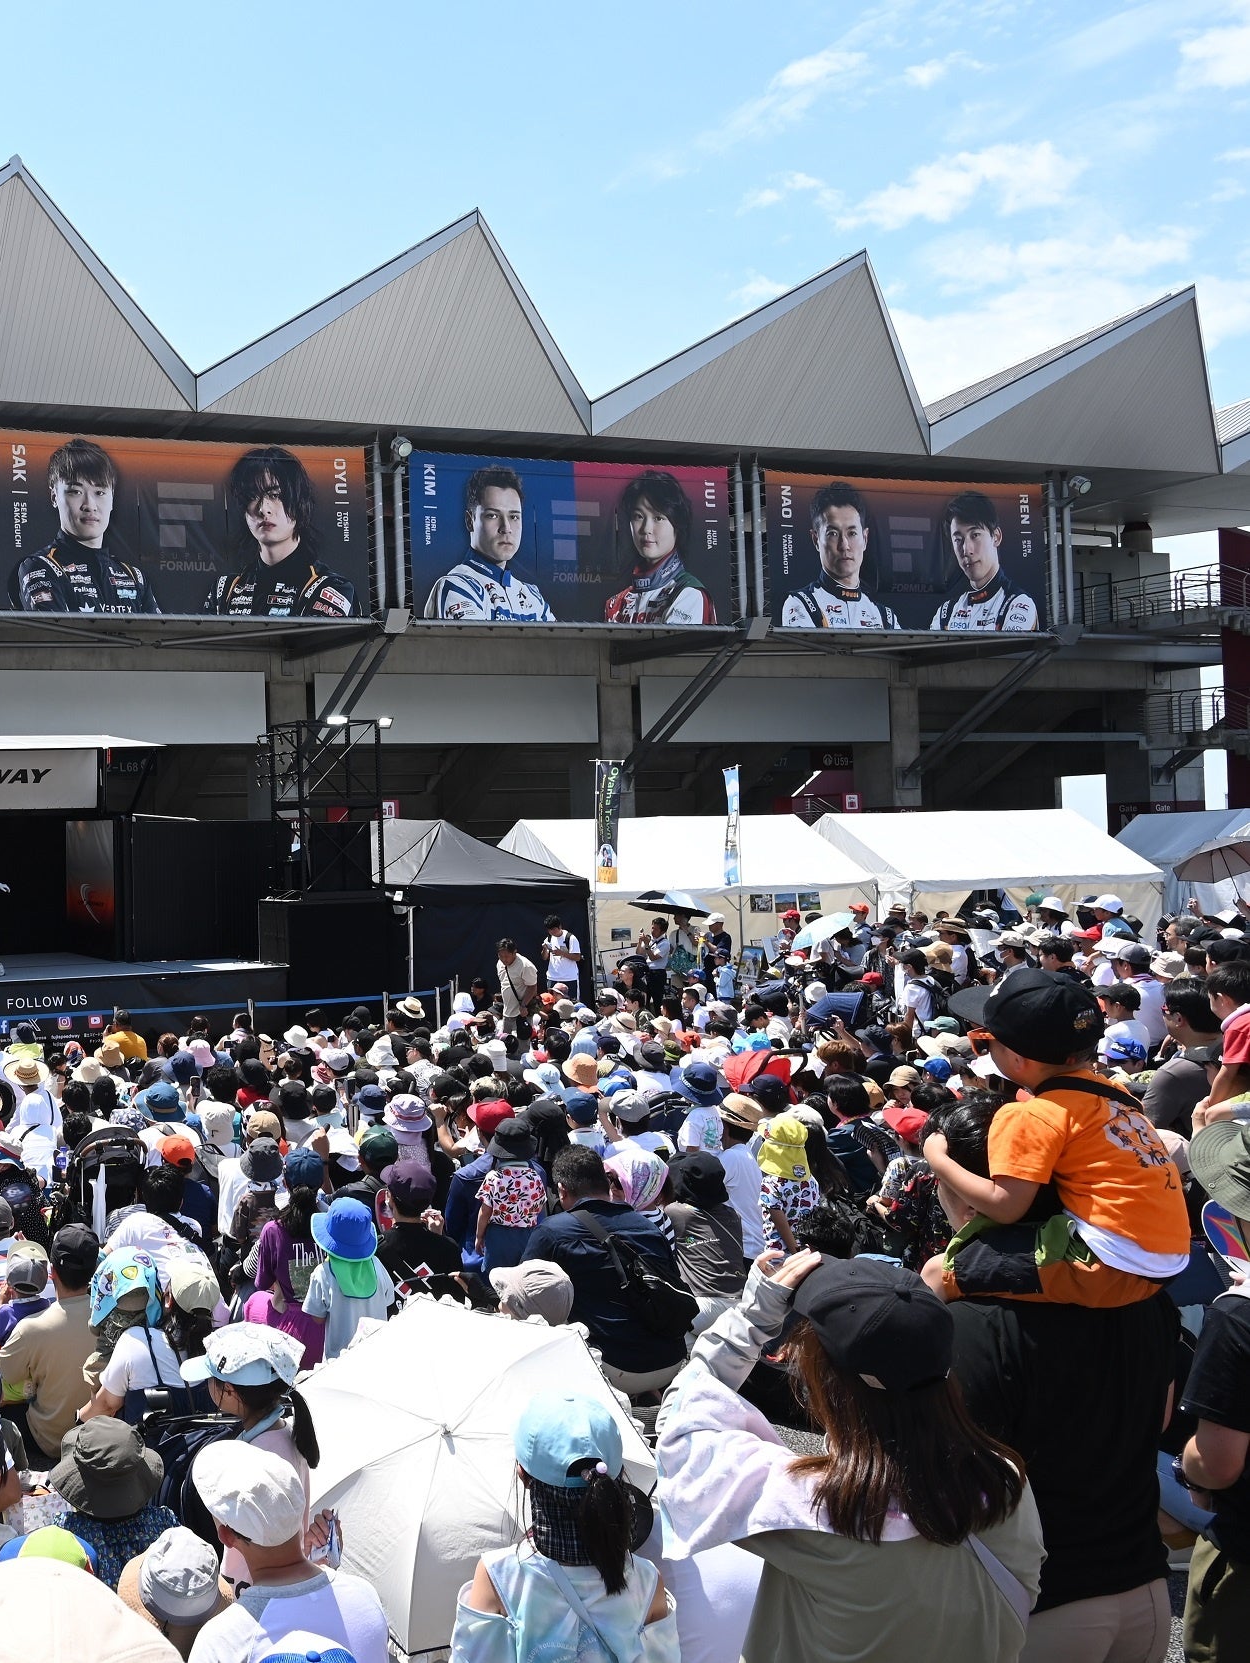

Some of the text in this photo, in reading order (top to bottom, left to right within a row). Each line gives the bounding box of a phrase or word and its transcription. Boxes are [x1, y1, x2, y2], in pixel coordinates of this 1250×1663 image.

[12, 444, 27, 482] SAK
[333, 458, 348, 494] OYU
[423, 463, 436, 496] KIM
[704, 479, 716, 508] JUJ
[20, 502, 28, 524] SENA
[780, 485, 792, 519] NAO
[1019, 494, 1030, 525] REN
[13, 501, 22, 548] SAKAGUCHI
[342, 512, 350, 542] TOSHIKI
[160, 561, 216, 573] FORMULA
[553, 572, 602, 583] FORMULA
[891, 583, 934, 594] FORMULA
[605, 767, 619, 840] Oyama Town
[1118, 805, 1138, 813] Gate
[1155, 804, 1171, 812] Gate
[7, 994, 88, 1009] FOLLOW US
[293, 1242, 313, 1267] The
